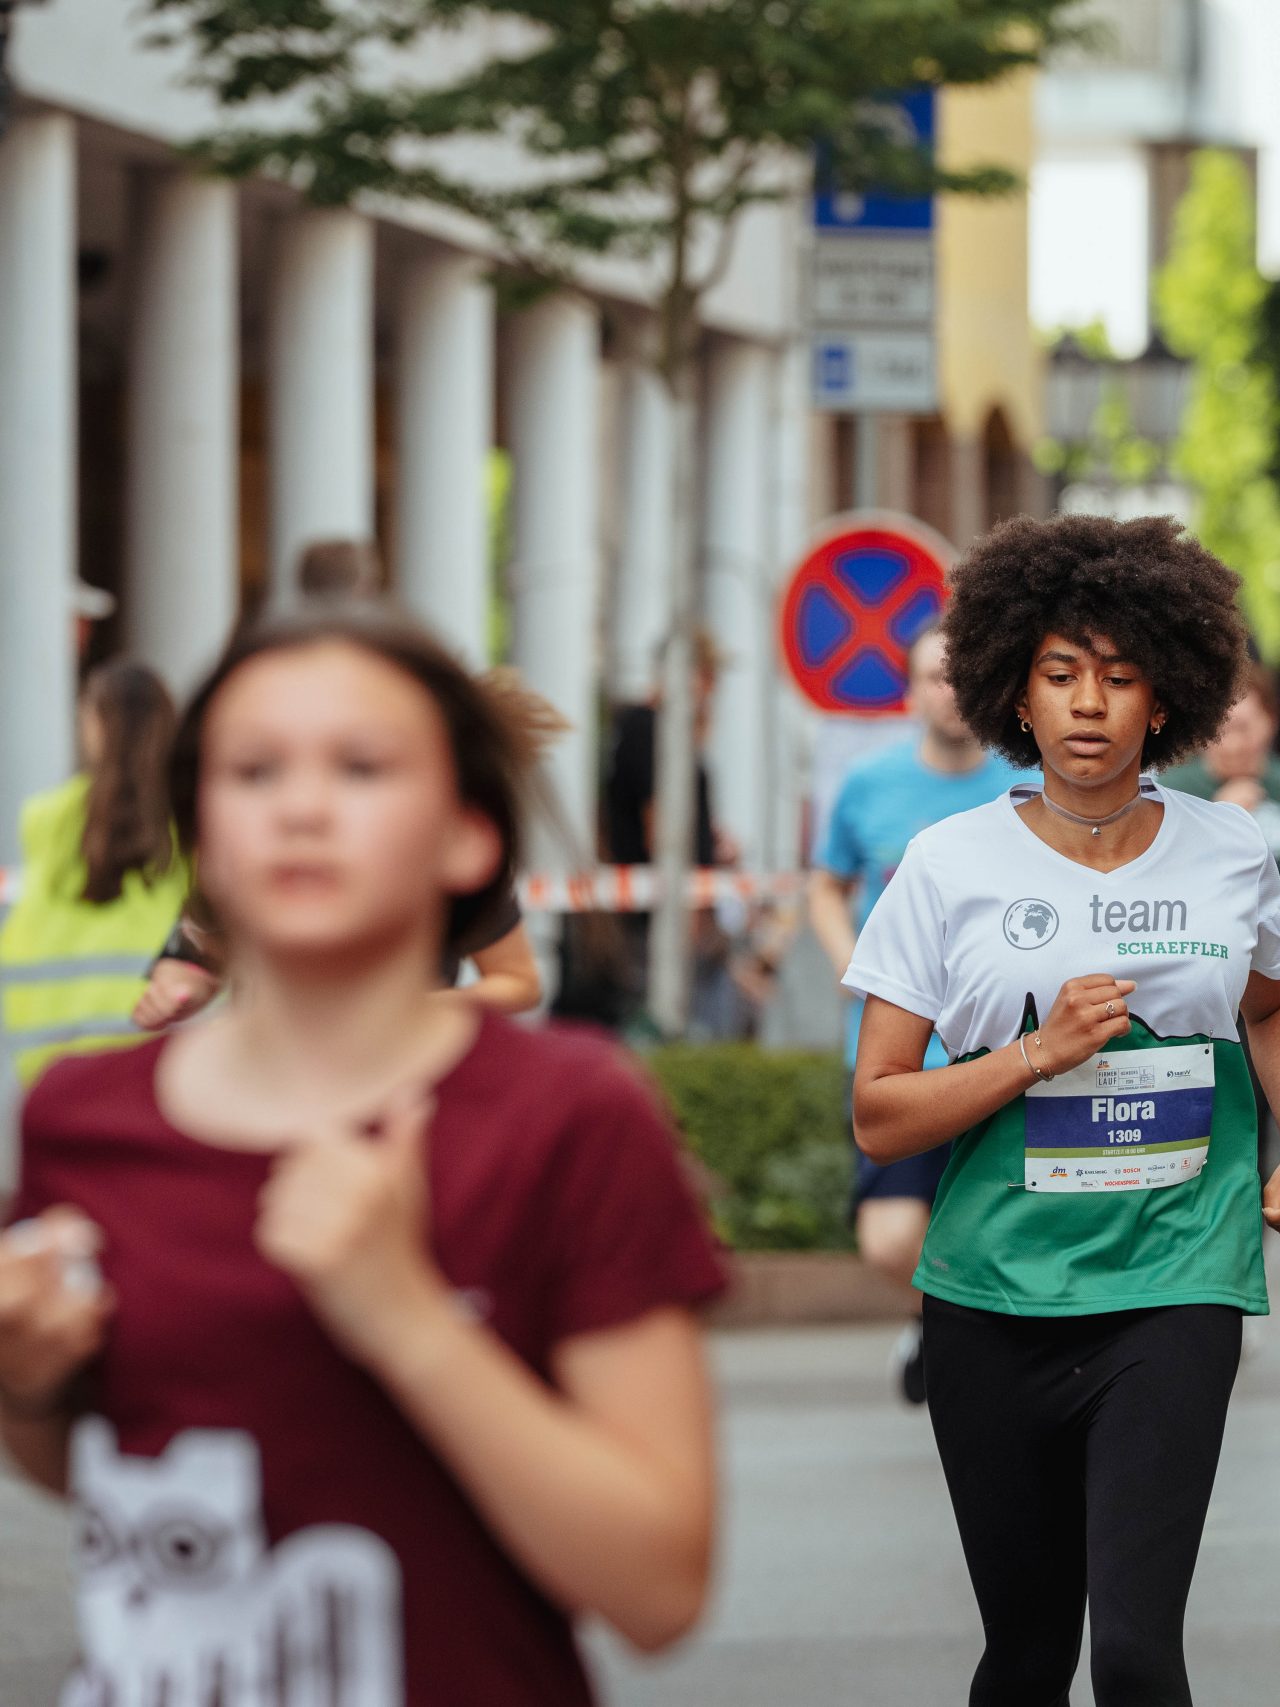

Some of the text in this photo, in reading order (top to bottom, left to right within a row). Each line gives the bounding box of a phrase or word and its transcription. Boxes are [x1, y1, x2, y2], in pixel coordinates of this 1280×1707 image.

[1089, 894, 1187, 933] team
[1117, 941, 1229, 959] SCHAEFFLER
[1098, 1077, 1117, 1086] LAUF
[1091, 1098, 1155, 1122] Flora
[1107, 1129, 1141, 1143] 1309
[1052, 1166, 1066, 1174] dm
